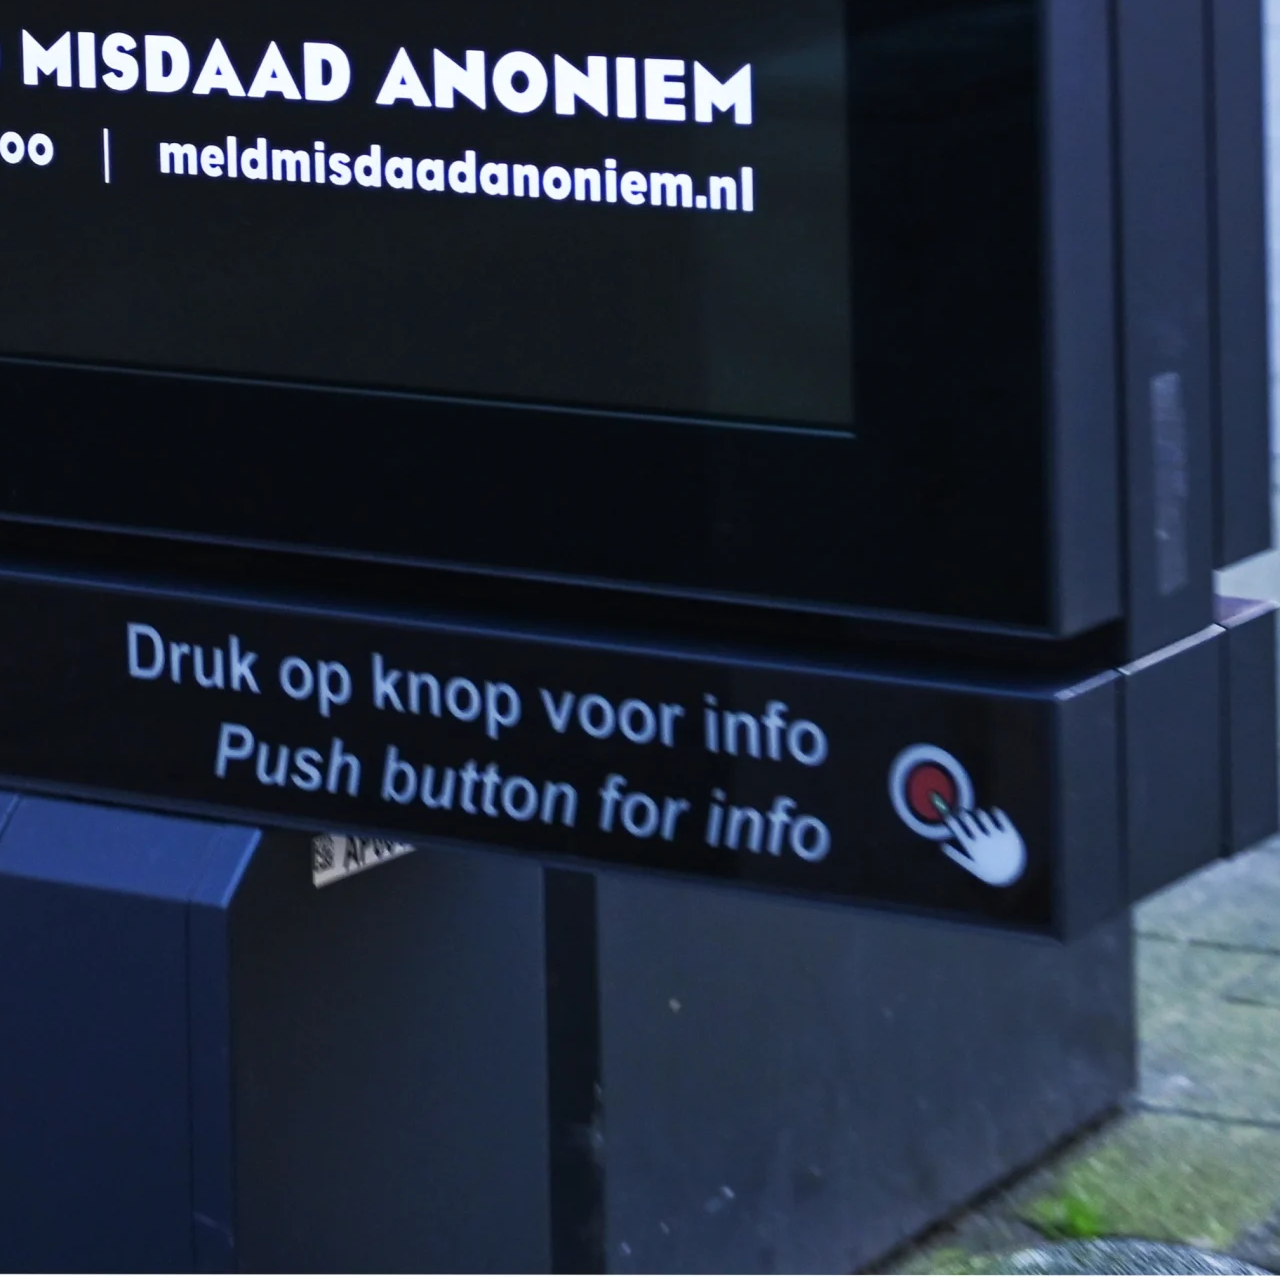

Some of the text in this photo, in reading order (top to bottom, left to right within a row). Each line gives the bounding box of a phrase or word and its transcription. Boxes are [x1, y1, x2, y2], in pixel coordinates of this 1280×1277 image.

[21, 28, 351, 102] MISDAAD
[375, 46, 753, 125] ANONIEM
[159, 135, 754, 212] meldmisdaadanoniem.nl
[127, 623, 827, 765] Druk op knop voor info
[216, 723, 829, 861] Push button for info
